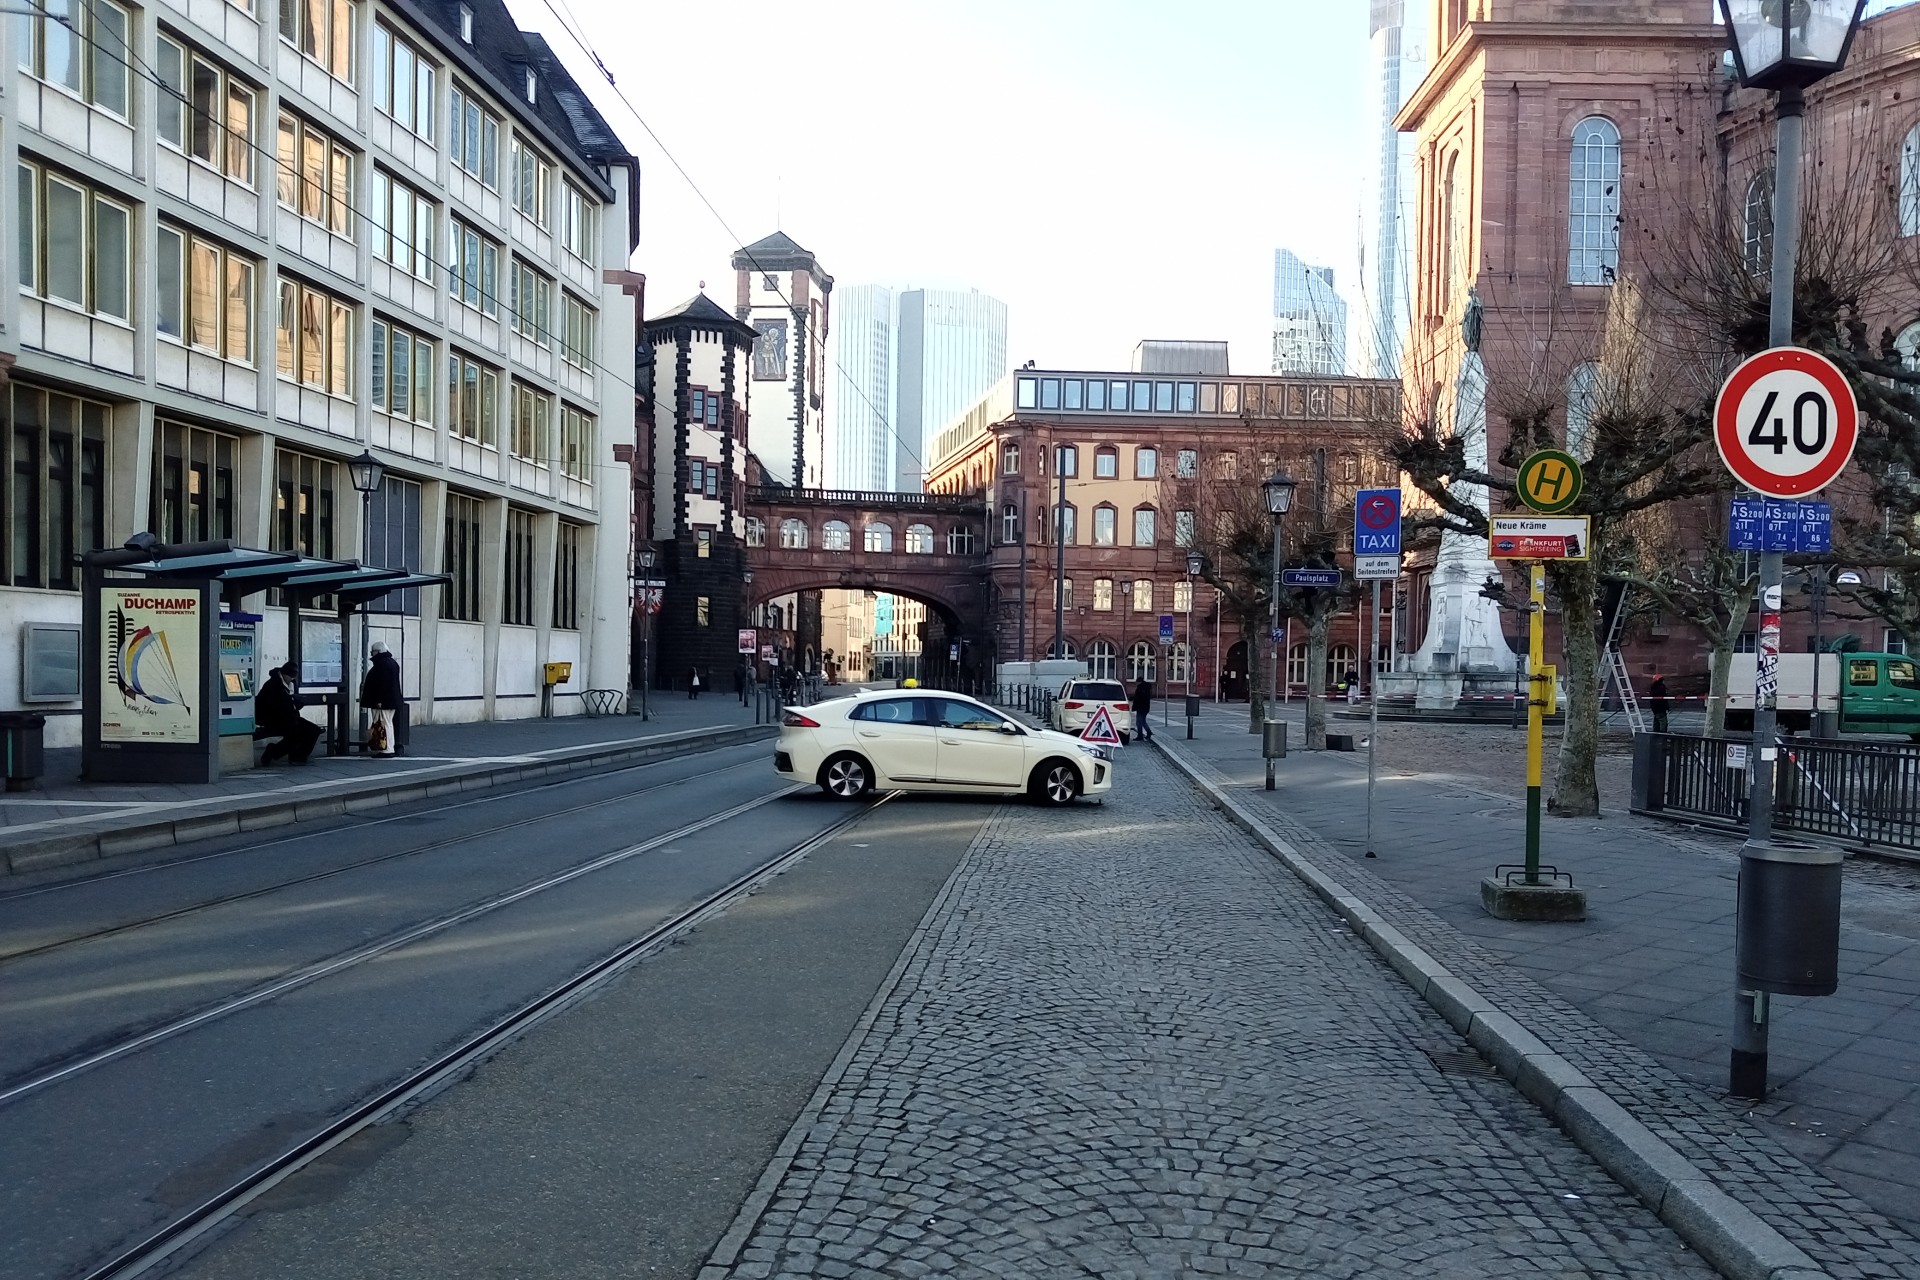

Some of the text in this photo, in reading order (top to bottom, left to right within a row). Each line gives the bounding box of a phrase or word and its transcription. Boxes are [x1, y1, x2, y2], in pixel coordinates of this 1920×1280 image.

[1748, 391, 1827, 455] 40
[1533, 462, 1566, 500] H
[1496, 521, 1547, 530] Neue Kräme
[1359, 534, 1395, 549] TAXI
[1295, 574, 1329, 583] Paulsplatz
[124, 598, 197, 610] DUCHAMP
[221, 639, 241, 649] TICKETS
